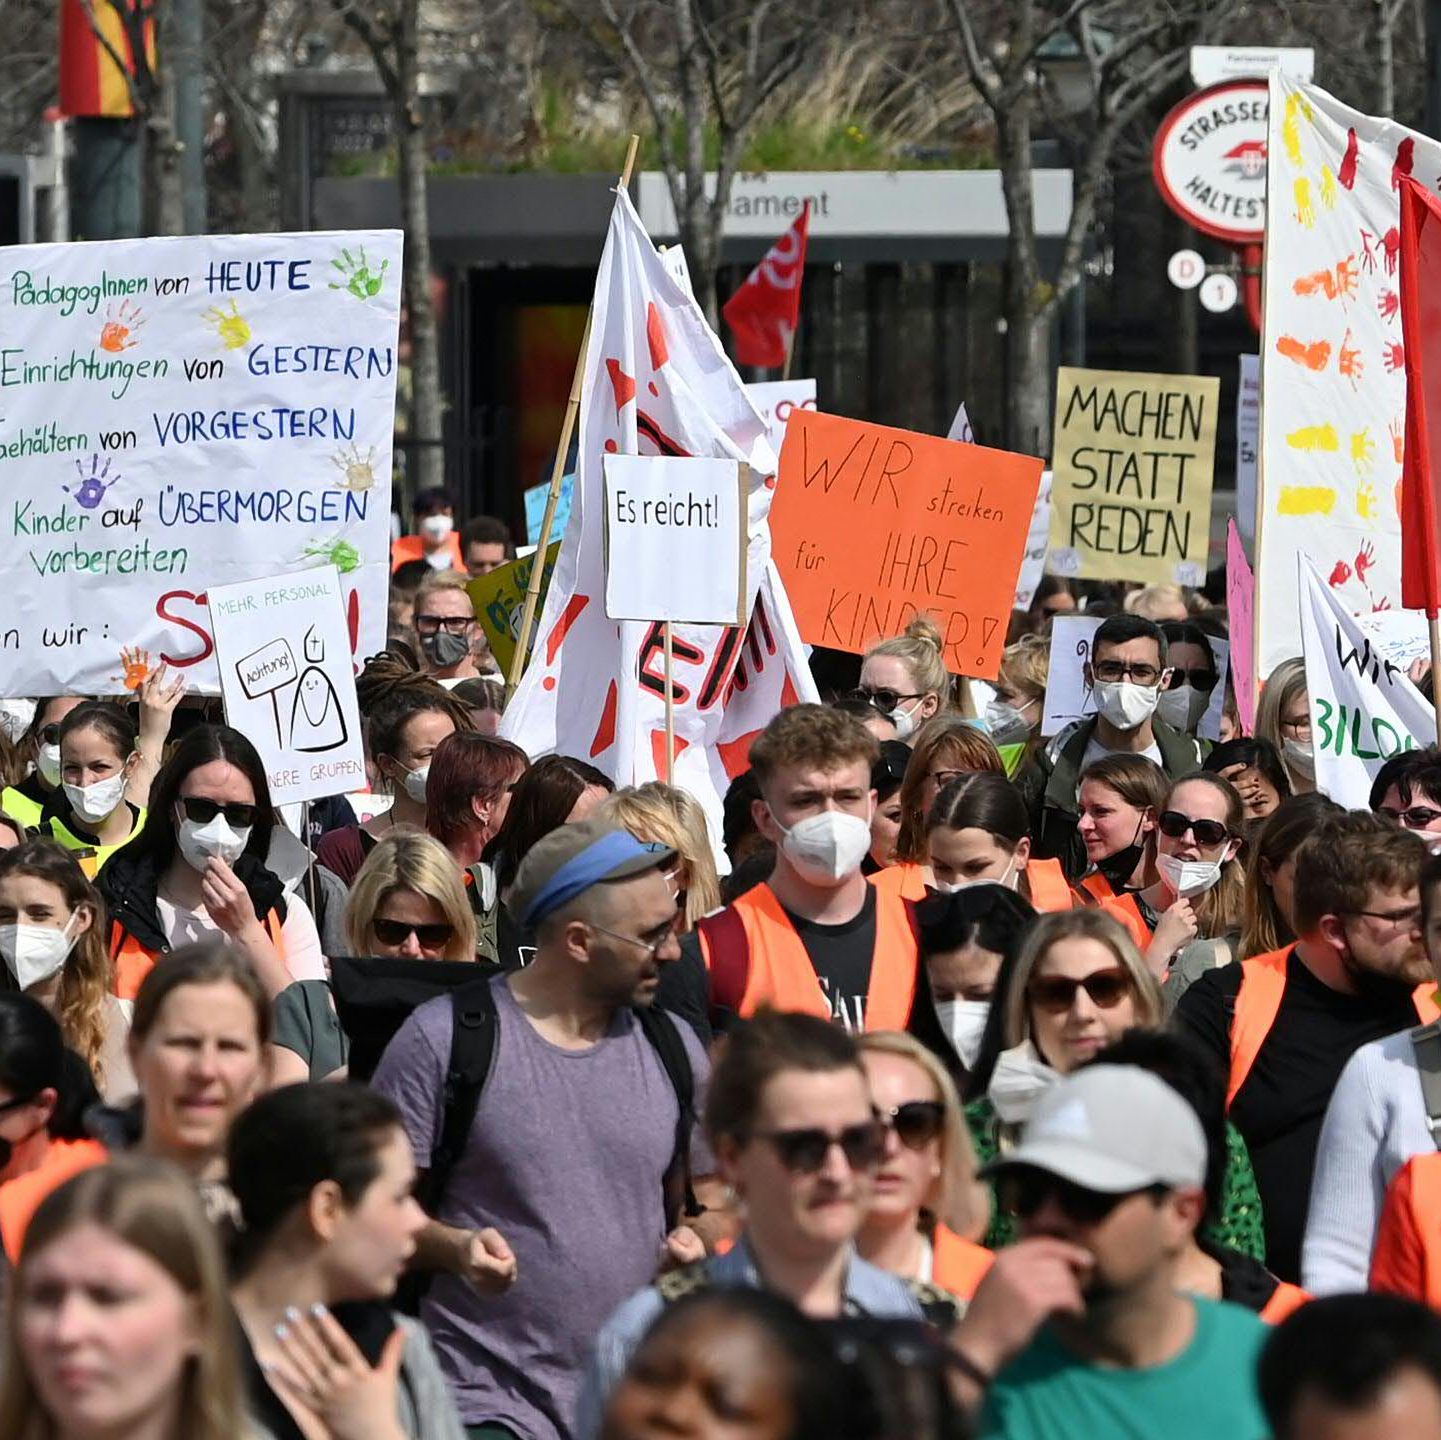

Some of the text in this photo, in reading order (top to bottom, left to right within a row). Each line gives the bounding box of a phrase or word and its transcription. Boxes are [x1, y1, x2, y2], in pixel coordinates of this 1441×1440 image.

[11, 270, 148, 317] PädagogInnen
[153, 276, 190, 297] von
[204, 258, 312, 296] HEUTE
[1178, 260, 1195, 278] D
[1216, 285, 1224, 302] 1
[0, 347, 169, 400] Einrichtungen
[184, 359, 225, 382] von
[247, 344, 393, 379] GESTERN
[99, 430, 138, 452] von
[152, 407, 357, 447] VORGESTERN
[1062, 383, 1205, 443] MACHEN
[803, 425, 1004, 522] WIR streiken
[1071, 446, 1197, 505] STATT
[13, 499, 91, 538] Kinder
[101, 498, 144, 532] auf
[158, 484, 369, 526] ÜBERMORGEN
[616, 490, 719, 529] Es reicht!
[1070, 502, 1191, 562] REDEN
[29, 539, 189, 579] vorbereiten
[795, 531, 969, 600] für IHRE
[217, 583, 332, 616] MEHR PERSONAL
[1335, 622, 1403, 687] Wir
[268, 759, 363, 789] NERE GRUPPEN
